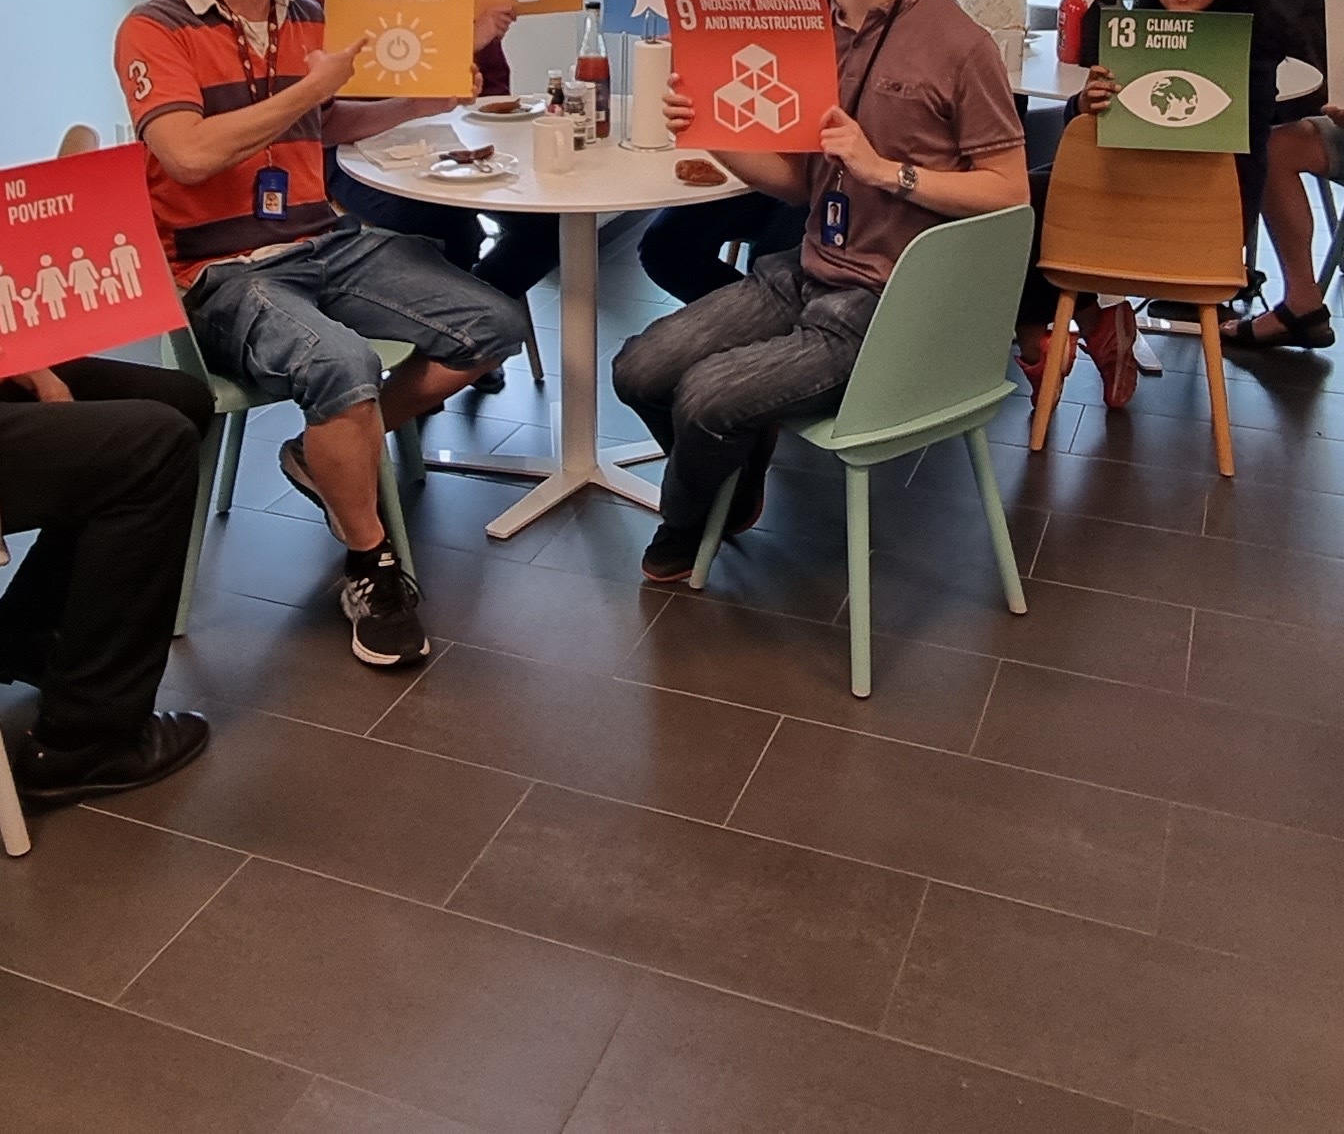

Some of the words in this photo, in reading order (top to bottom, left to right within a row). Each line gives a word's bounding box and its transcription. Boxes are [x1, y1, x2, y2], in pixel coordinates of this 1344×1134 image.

[705, 16, 729, 30] AND
[728, 16, 825, 31] INFRASTRUCTURE
[1107, 17, 1137, 49] 13
[1145, 18, 1195, 33] CLIMATE
[1145, 34, 1188, 50] ACTION
[128, 58, 154, 101] 3
[5, 179, 26, 201] NO
[8, 193, 74, 226] POVERTY
